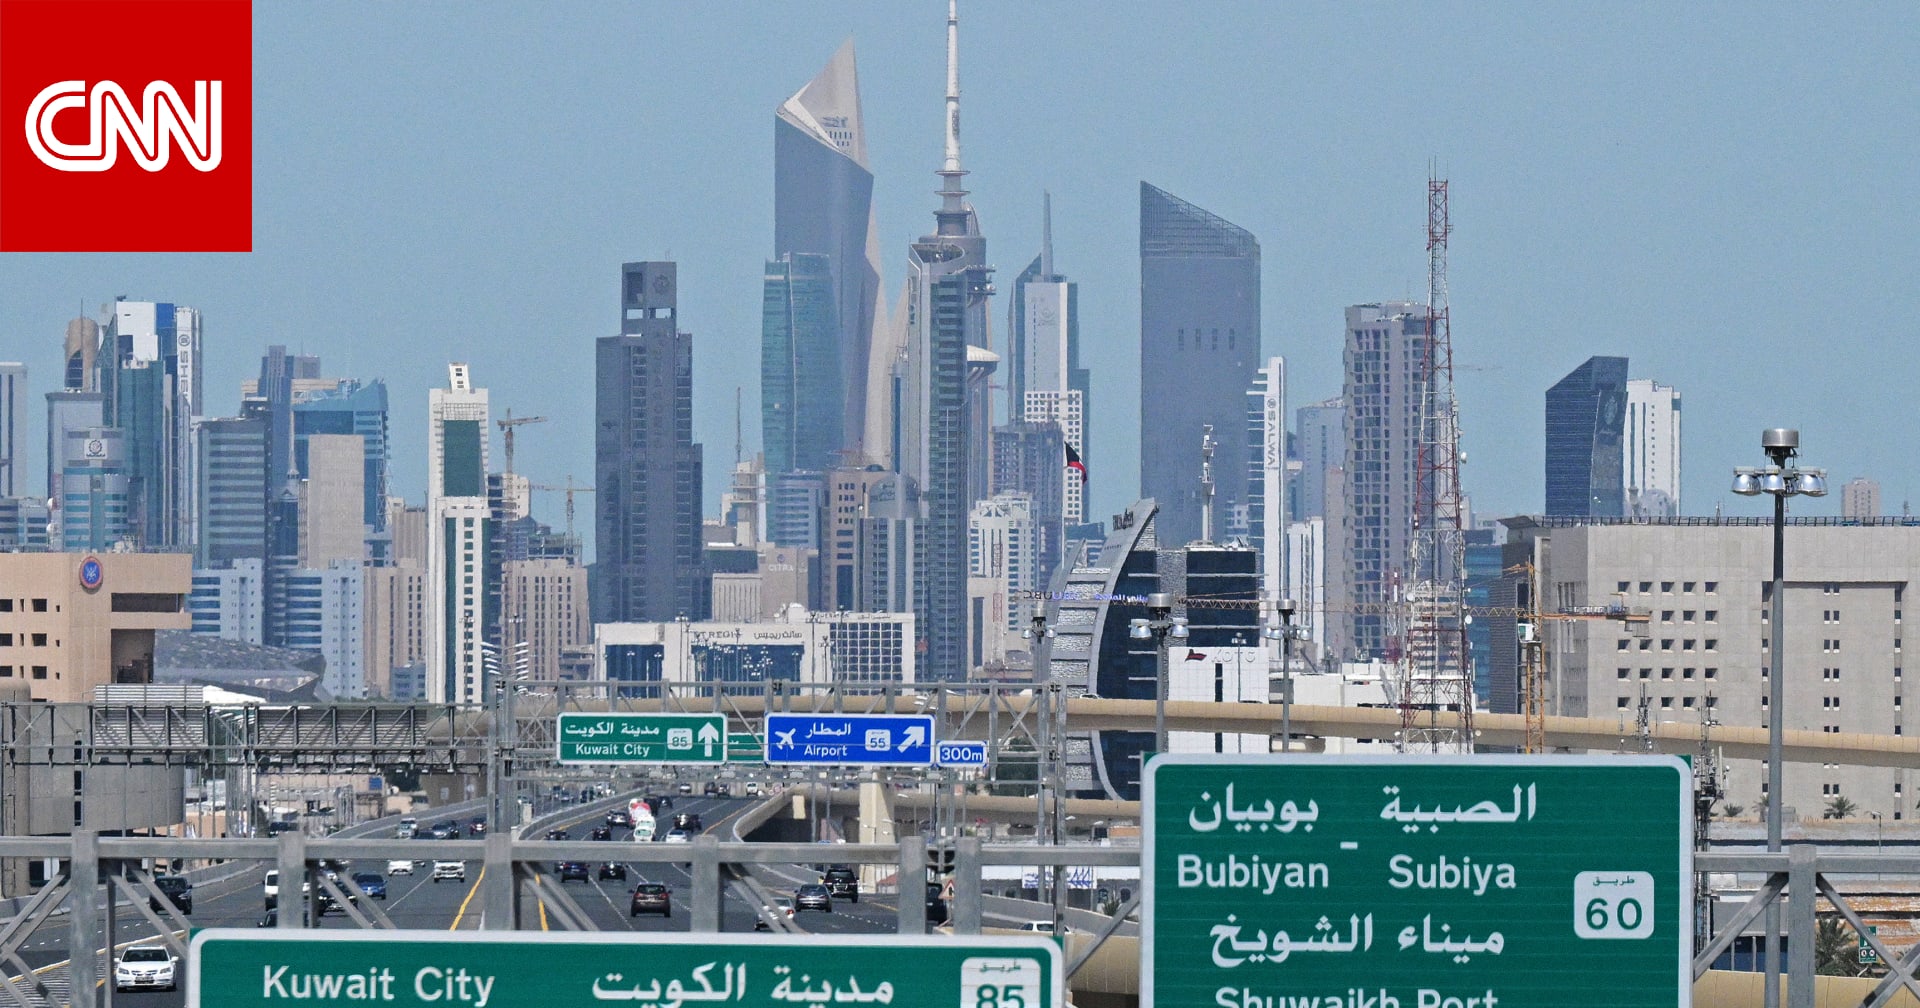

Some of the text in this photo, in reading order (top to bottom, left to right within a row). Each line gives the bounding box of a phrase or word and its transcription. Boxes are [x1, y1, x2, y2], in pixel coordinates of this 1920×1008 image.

[1267, 410, 1276, 466] SALWA
[565, 721, 660, 738] مدينة الكويت
[672, 736, 688, 747] 85
[805, 722, 851, 738] المطار
[870, 737, 886, 748] 55
[575, 744, 650, 757] Kuwait City
[804, 744, 848, 758] Airport
[941, 747, 983, 761] 300m
[1188, 781, 1319, 833] بوبيان
[1380, 781, 1537, 834] الصبية
[1177, 853, 1329, 895] Bubiyan
[1388, 853, 1517, 896] Subiya
[1592, 875, 1635, 887] طريق
[1586, 897, 1643, 931] 60
[1209, 911, 1505, 969] ميناء الشويخ
[263, 965, 496, 1008] Kuwait City
[592, 961, 895, 1008] مدينة الكويت
[975, 984, 1025, 1008] 85
